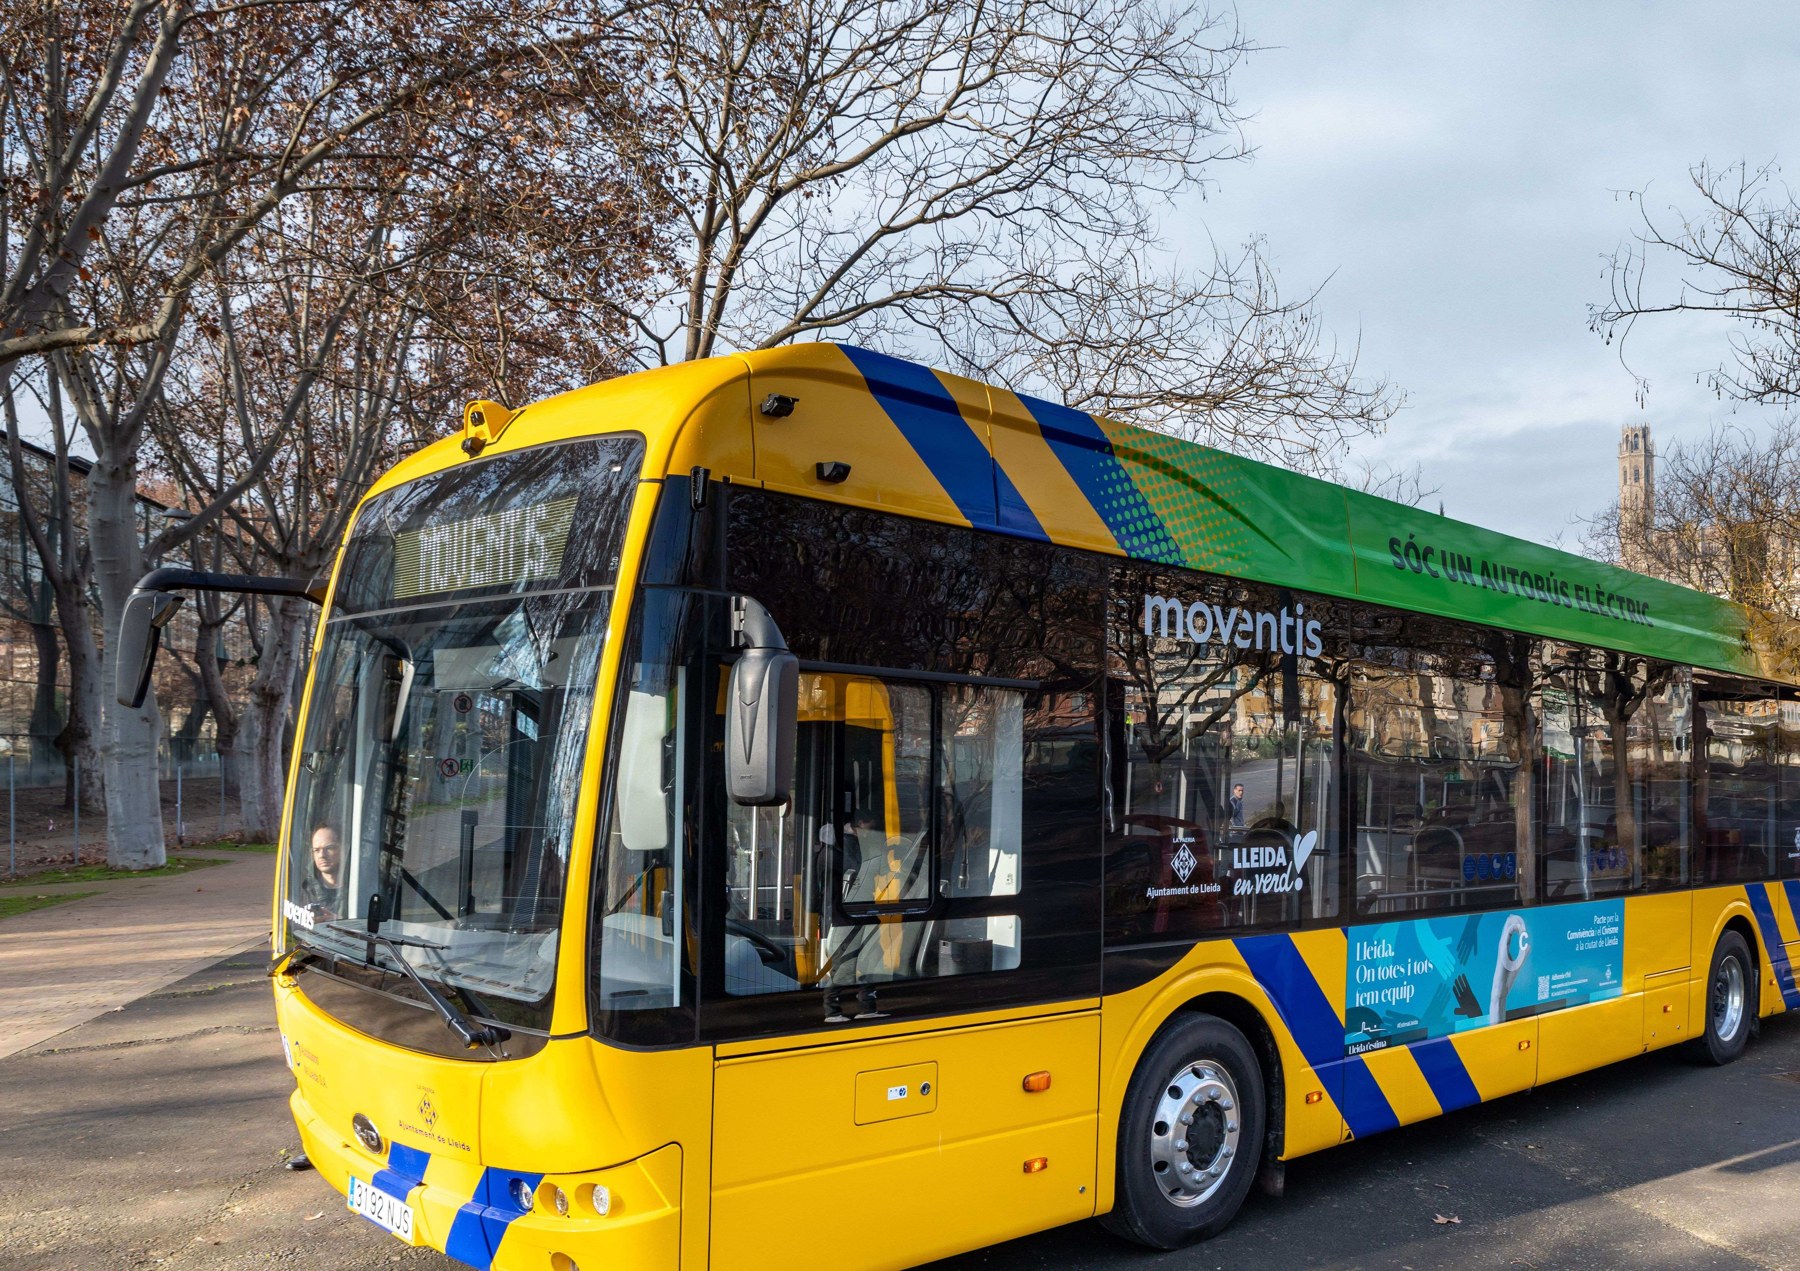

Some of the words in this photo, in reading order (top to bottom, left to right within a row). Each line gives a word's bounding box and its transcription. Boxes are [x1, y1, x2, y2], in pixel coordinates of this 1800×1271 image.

[1388, 533, 1440, 578] SÓC
[1440, 549, 1475, 587] UN
[1480, 560, 1573, 609] AUTOBÚS
[1574, 583, 1655, 627] ELÈCTRIC
[1144, 593, 1323, 658] moventis
[1233, 846, 1287, 869] LLEIDA
[1146, 885, 1189, 899] Ajuntament
[1190, 885, 1199, 894] de
[1200, 883, 1221, 894] Lleida
[1233, 877, 1254, 896] en
[1594, 915, 1606, 924] Pacte
[1606, 916, 1614, 925] per
[1614, 912, 1619, 922] la
[1356, 939, 1395, 961] Lleida.
[1598, 938, 1604, 948] de
[1604, 936, 1619, 947] Lleida
[1356, 964, 1375, 984] On
[1378, 963, 1405, 980] totes
[1414, 958, 1434, 975] tots
[1381, 980, 1415, 1006] equip
[1348, 1043, 1365, 1055] Lleida
[399, 1120, 436, 1140] Ajuntament
[437, 1135, 446, 1144] de
[447, 1138, 471, 1152] Lleida
[356, 1184, 384, 1220] 3192
[387, 1200, 410, 1234] NJS
